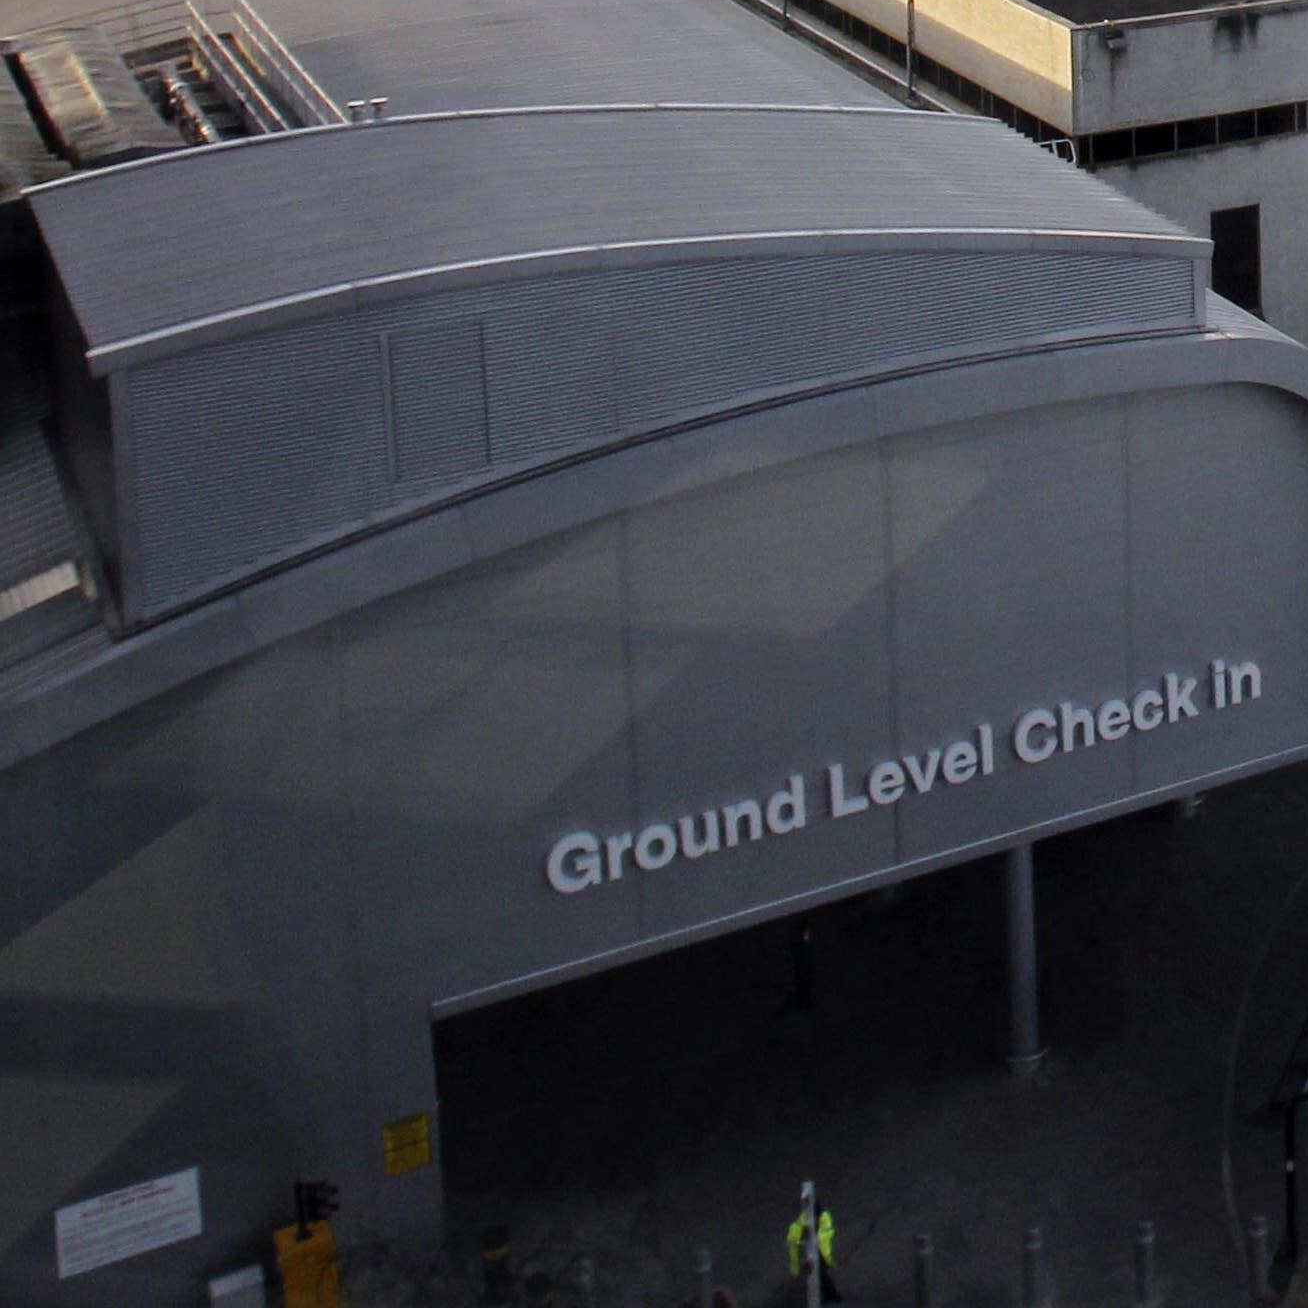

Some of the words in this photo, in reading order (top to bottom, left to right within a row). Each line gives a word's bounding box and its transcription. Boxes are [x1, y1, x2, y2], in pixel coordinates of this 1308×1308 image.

[546, 775, 807, 893] Ground
[829, 725, 994, 818] Level
[1012, 673, 1198, 765] Check
[1213, 659, 1262, 709] in
